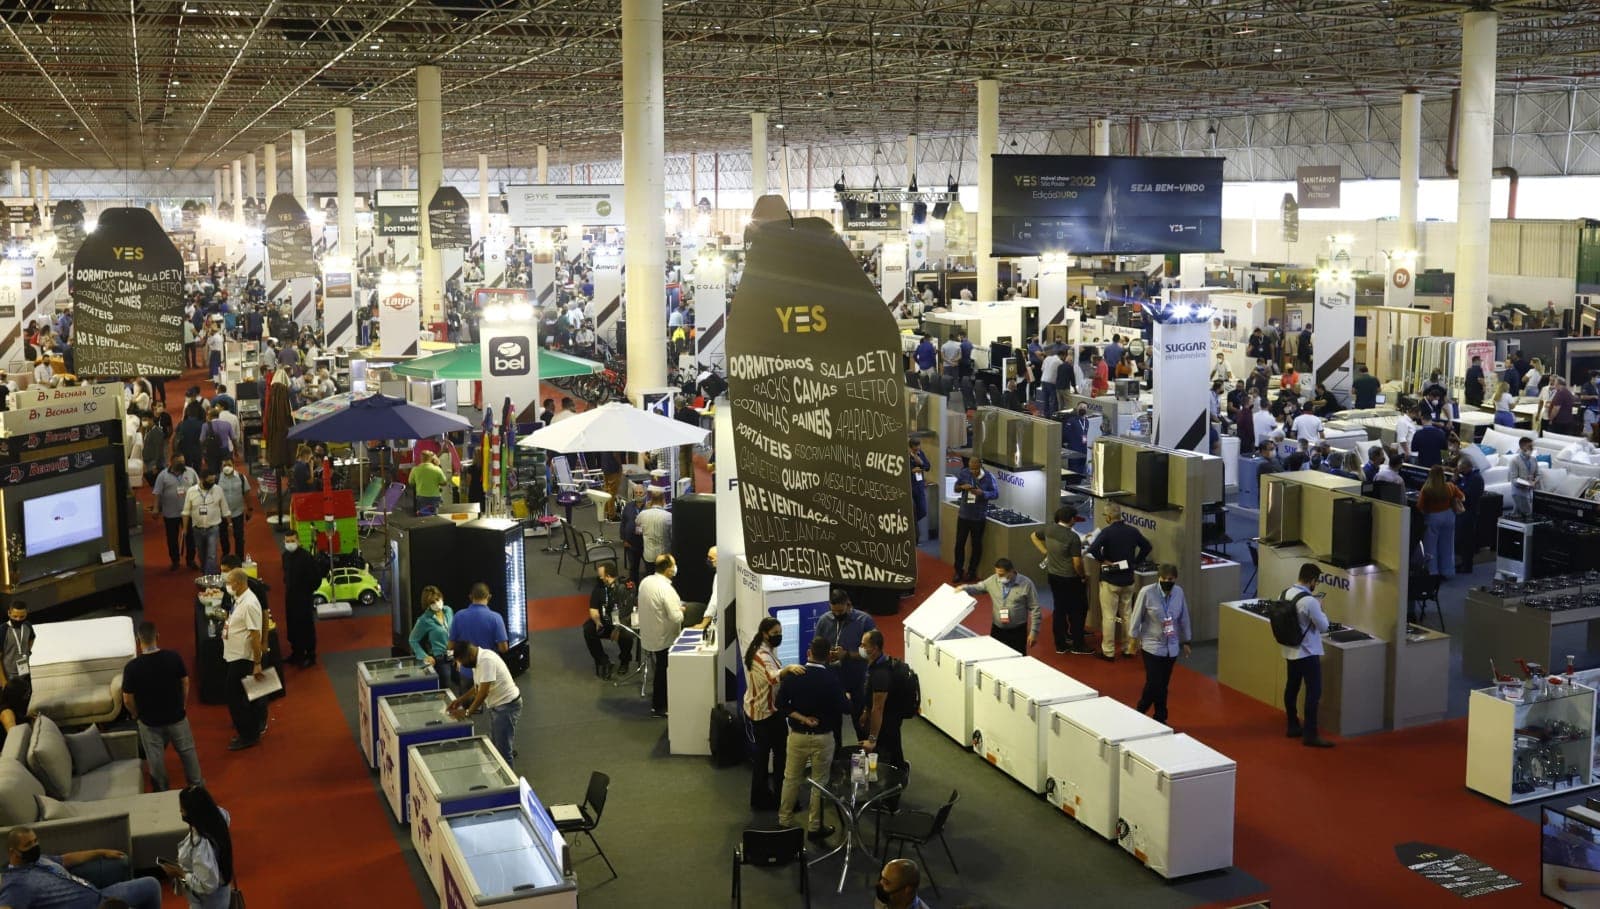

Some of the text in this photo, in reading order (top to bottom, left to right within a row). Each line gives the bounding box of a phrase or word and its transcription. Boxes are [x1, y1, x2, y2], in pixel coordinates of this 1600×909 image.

[1014, 176, 1037, 187] YES
[1070, 176, 1096, 187] 2022
[1303, 176, 1336, 184] SANITÁRIOS
[1130, 184, 1205, 192] SEJA BEM-VINDO
[113, 247, 144, 260] YES
[77, 269, 182, 282] DORMITÓRIOS SALA DE TV
[152, 283, 182, 295] ELETRO
[160, 314, 183, 326] BIKES
[775, 305, 828, 333] YES
[105, 323, 131, 335] QUARTO
[77, 331, 88, 346] AR
[88, 333, 94, 346] E
[1165, 342, 1206, 353] SUGGAR
[78, 366, 97, 375] SALA
[98, 362, 108, 375] DE
[109, 362, 134, 375] ESTAR
[495, 355, 525, 370] bel
[730, 350, 896, 380] DORMITÓRIOS SALA DE TV
[54, 390, 87, 400] BECHARA
[753, 376, 898, 407] RACKS CAMAS ELETRO
[45, 407, 78, 417] BECHARA
[733, 398, 903, 441] COZINHAS PAINÉIS APARADORES
[736, 422, 904, 477] PORTÁTEIS ESCRIVANINHA BIKES
[781, 467, 820, 491] QUARTO
[823, 471, 844, 491] MESA
[845, 475, 857, 494] DE
[997, 471, 1025, 488] SUGGAR
[742, 481, 760, 510] AR
[758, 487, 768, 511] E
[768, 491, 839, 525] VENTILAÇÃO
[812, 492, 876, 537] CRISTALEIRAS
[878, 508, 909, 535] SOFÁS
[1121, 511, 1157, 531] SUGGAR
[745, 515, 837, 543] SALA DE JANTAR
[840, 540, 911, 568] POLTRONAS
[752, 547, 915, 583] SALA DE ESTAR ESTANTES
